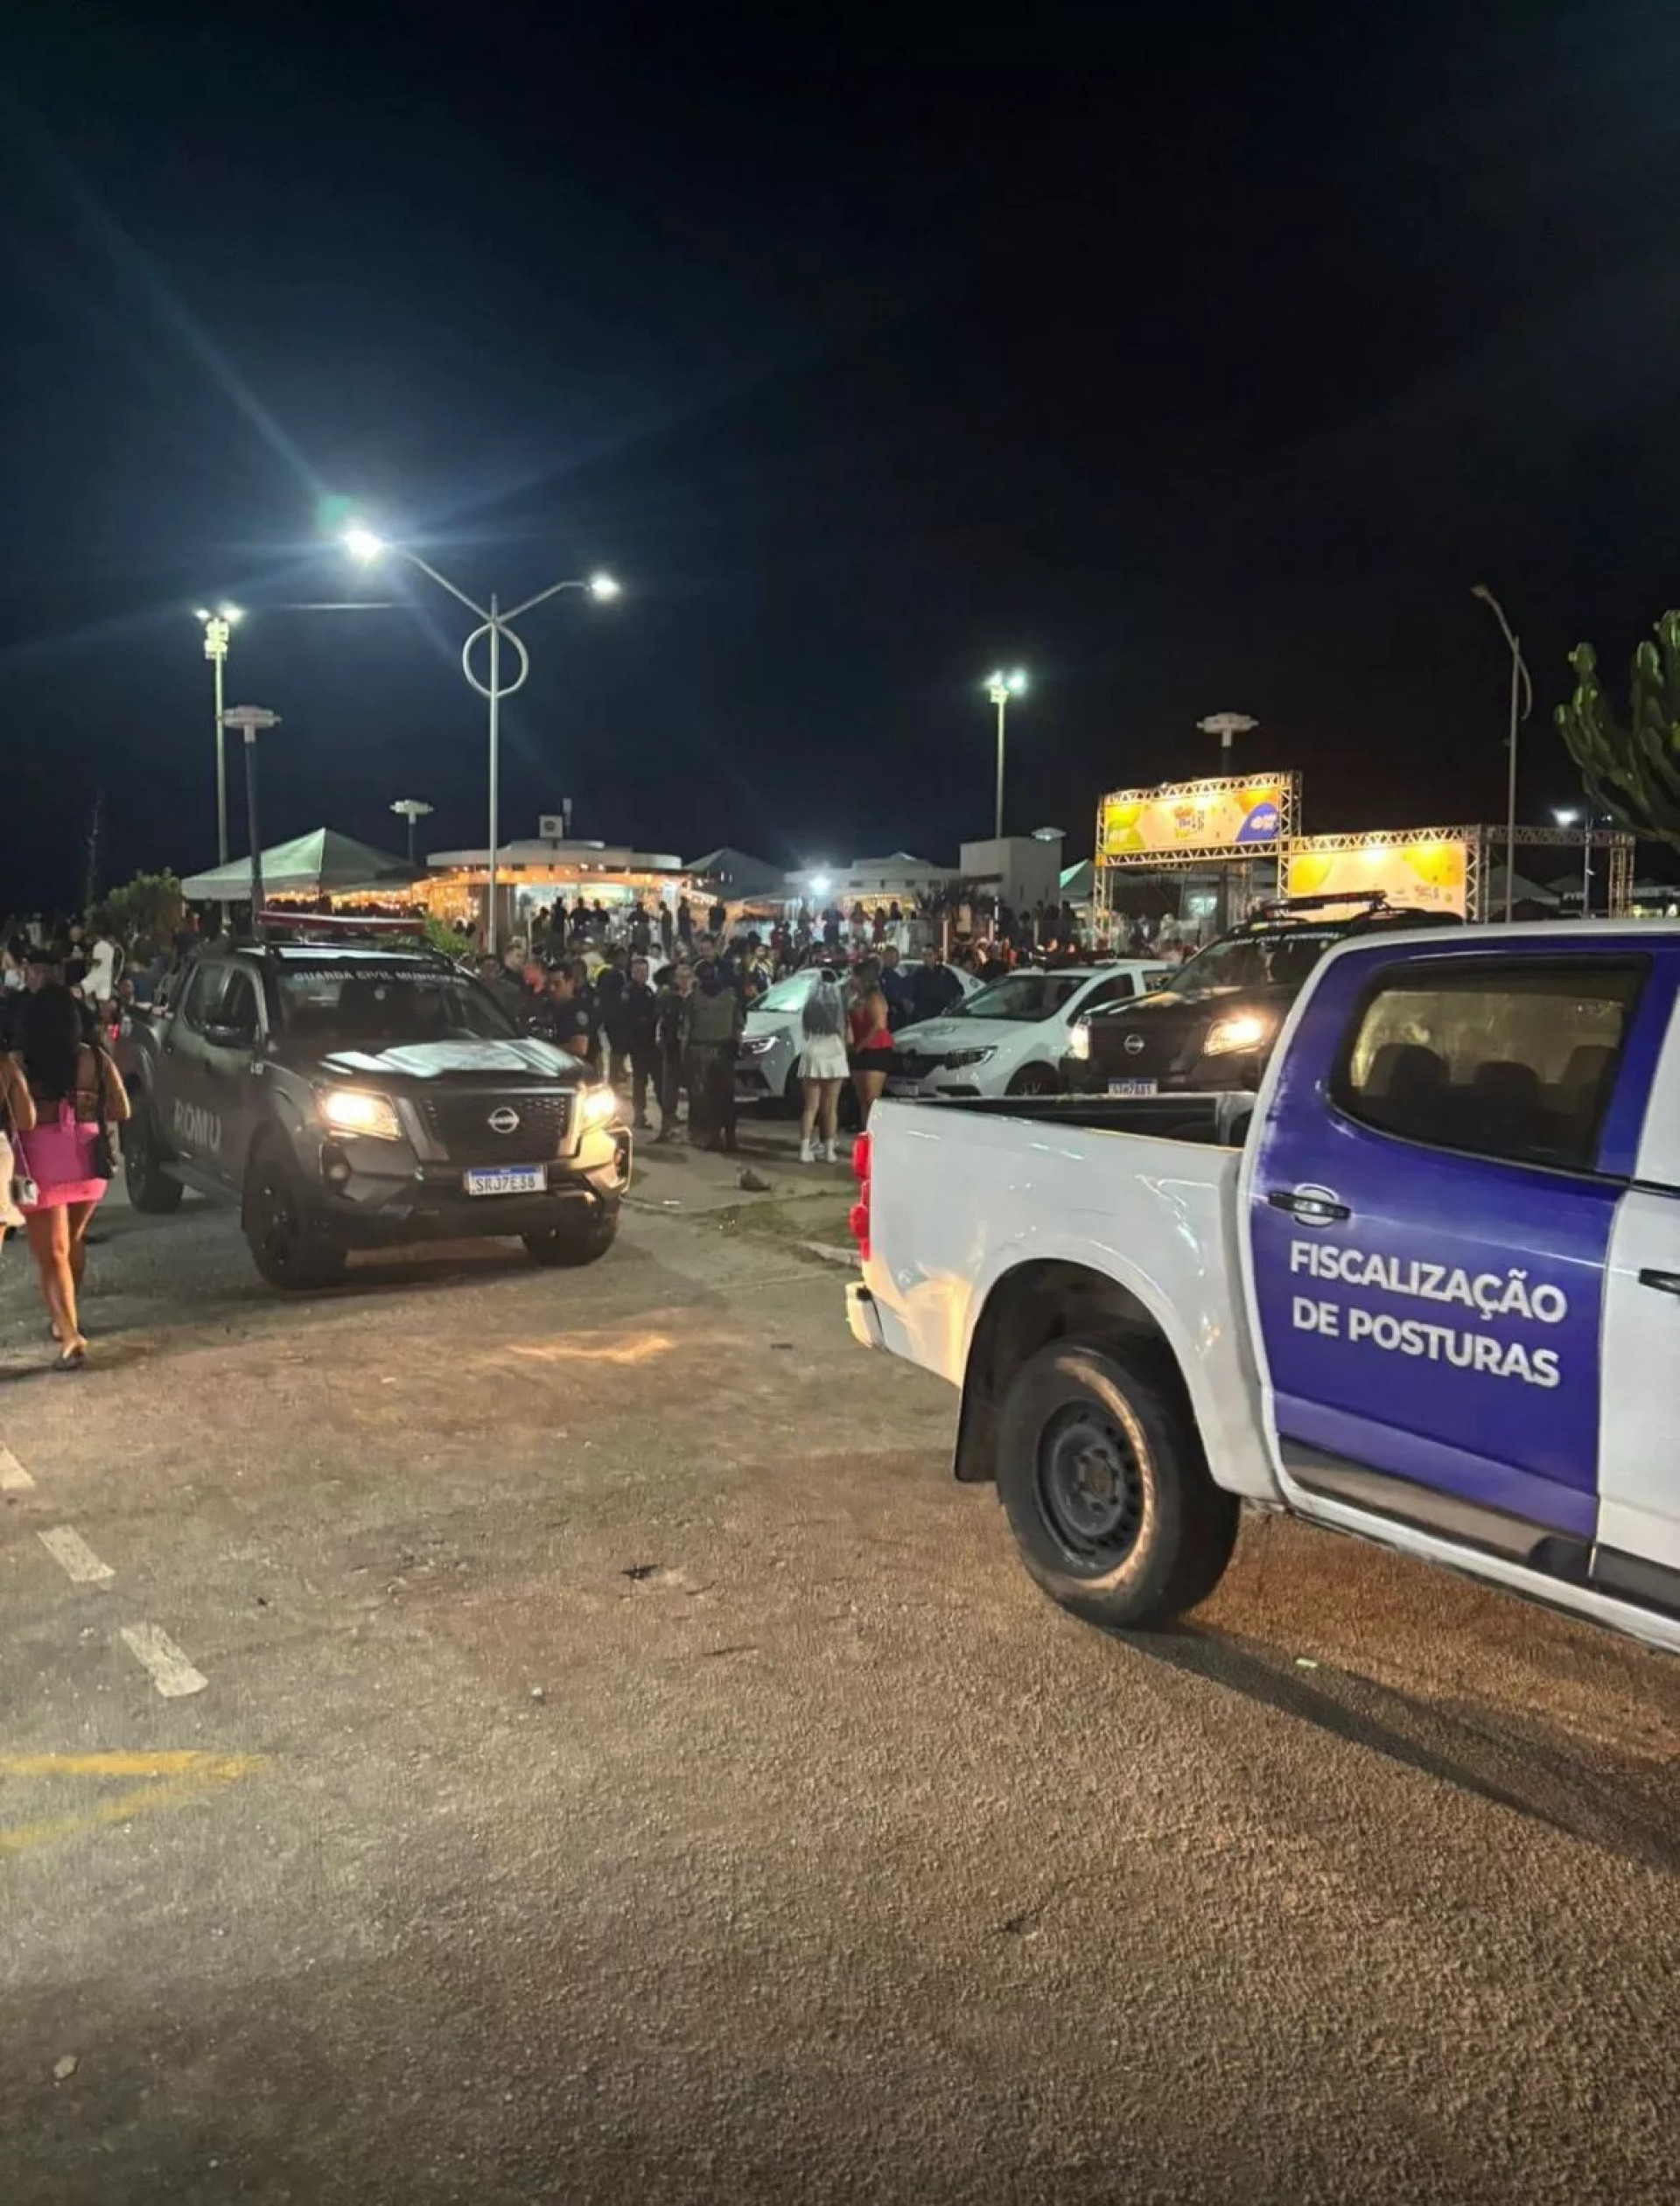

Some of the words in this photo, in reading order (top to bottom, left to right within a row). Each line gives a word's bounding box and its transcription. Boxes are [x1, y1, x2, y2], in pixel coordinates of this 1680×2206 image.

[292, 970, 354, 981] GUARDA
[174, 1098, 221, 1153] ROMU
[1290, 1240, 1567, 1323] FISCALIZAÇÃO
[1292, 1297, 1340, 1336] DE
[1348, 1308, 1560, 1388] POSTURAS
